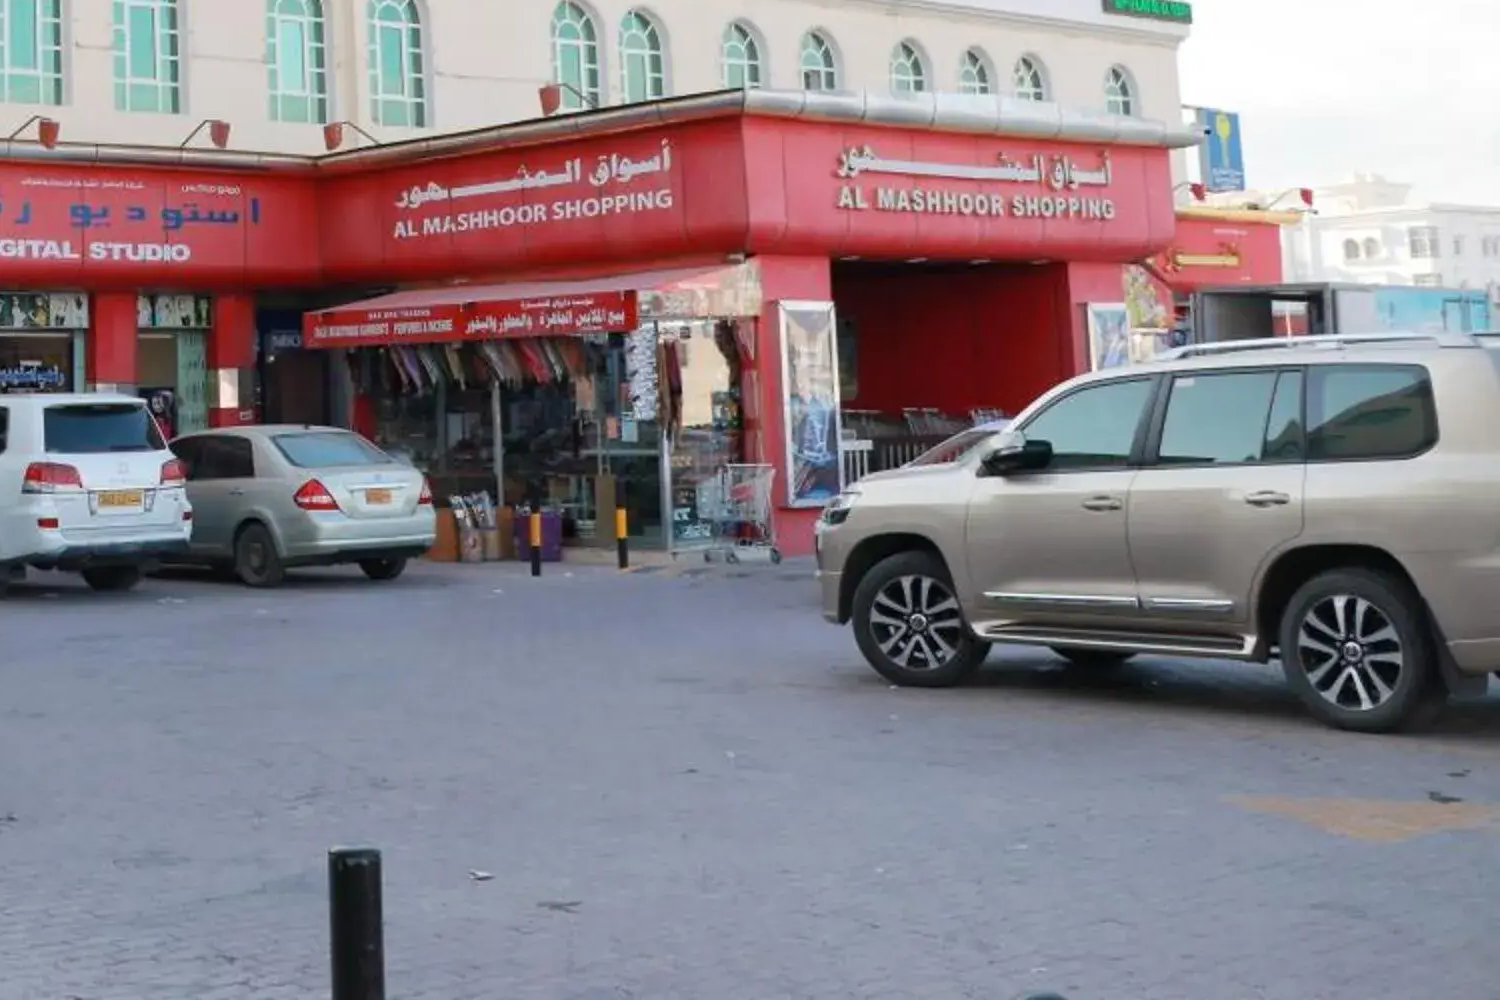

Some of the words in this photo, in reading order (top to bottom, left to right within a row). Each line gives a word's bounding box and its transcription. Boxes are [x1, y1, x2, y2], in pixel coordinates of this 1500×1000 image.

[836, 145, 1046, 183] المشهور
[394, 158, 581, 209] المشهور
[393, 219, 418, 239] AL
[422, 203, 548, 234] MASHHOOR
[552, 189, 674, 220] SHOPPING
[838, 186, 868, 210] AL
[877, 187, 1005, 216] MASHHOOR
[1012, 194, 1116, 220] SHOPPING
[89, 241, 192, 262] STUDIO
